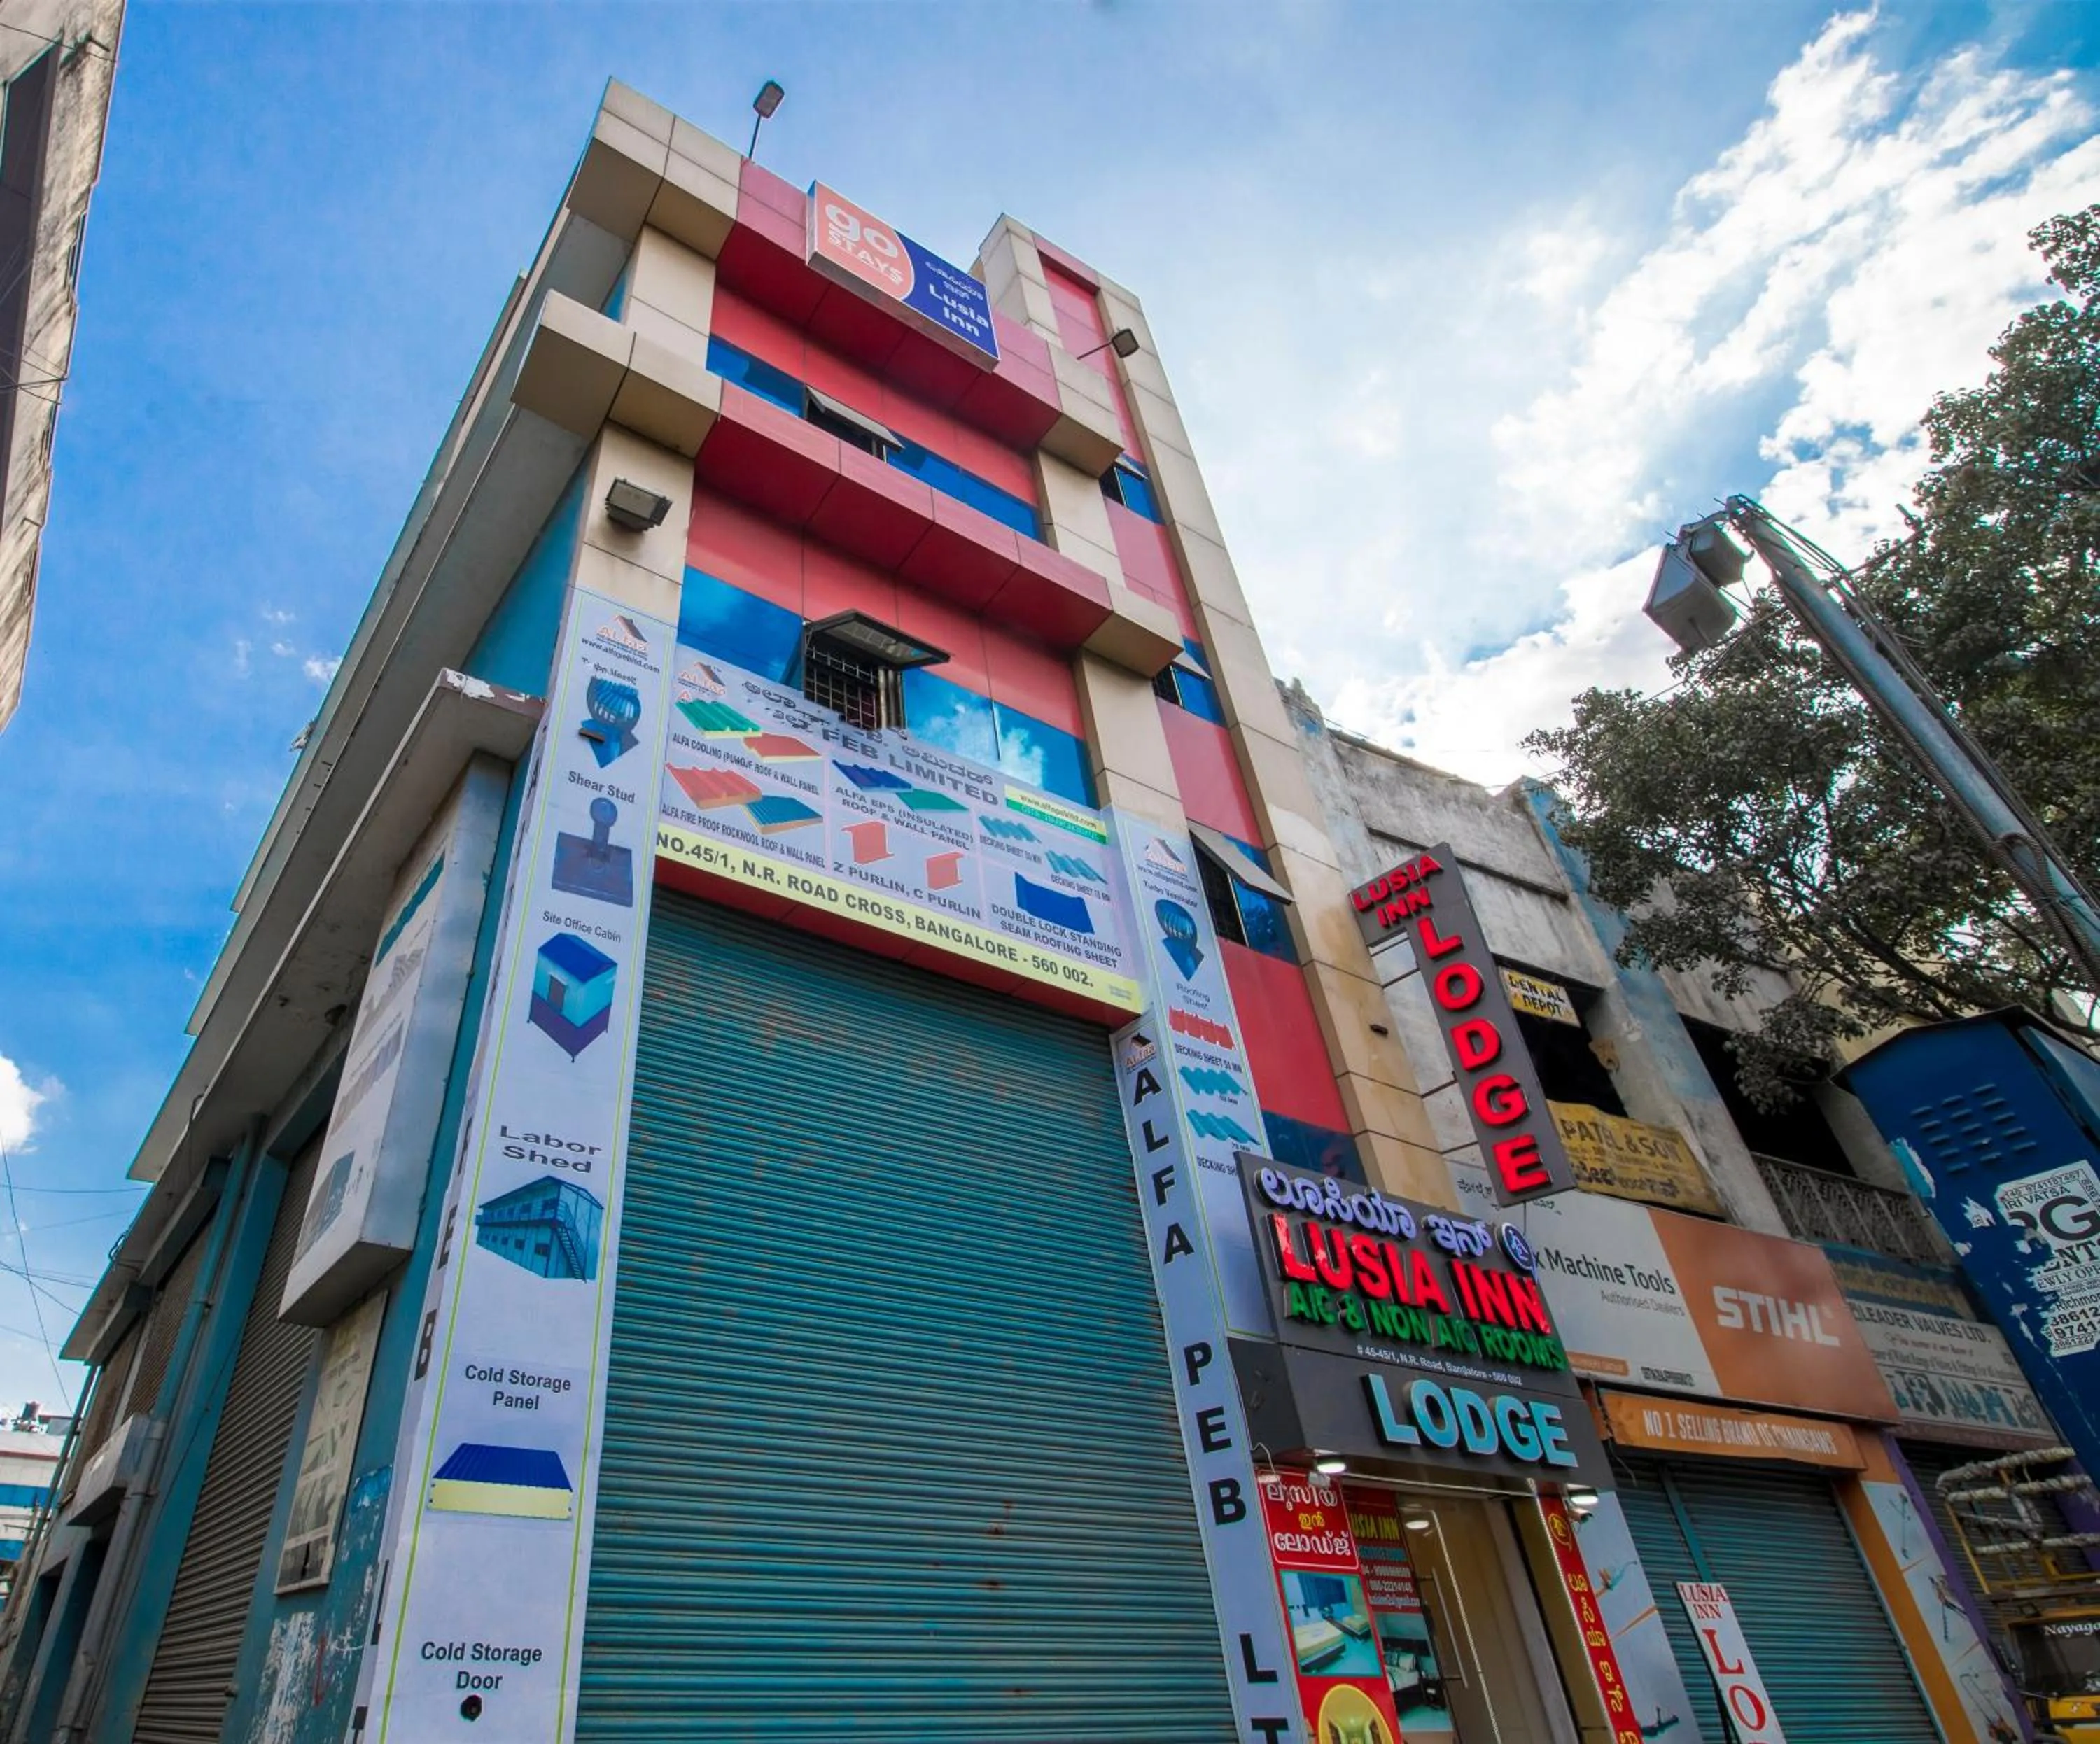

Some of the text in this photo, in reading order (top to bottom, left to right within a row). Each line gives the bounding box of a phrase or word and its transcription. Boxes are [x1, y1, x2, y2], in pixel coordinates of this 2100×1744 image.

[828, 230, 904, 286] STAYS
[929, 283, 989, 328] Lusia
[943, 306, 979, 337] Inn
[568, 770, 636, 804] Shear Stud
[836, 785, 867, 804] ALFA
[889, 752, 999, 806] LIMITED
[841, 798, 878, 817] ROOF
[894, 817, 928, 836] WALL
[931, 831, 970, 851] PANEL
[834, 862, 844, 873] Z
[913, 887, 924, 899] C
[927, 892, 981, 920] PURLIN
[1350, 855, 1443, 910] LUSIA
[657, 831, 736, 874] NO.45/1,
[743, 859, 781, 886] N.R.
[788, 873, 839, 903] ROAD
[845, 893, 911, 930] CROSS,
[914, 914, 1018, 964] BANGALORE
[1031, 955, 1059, 977] 560
[1062, 966, 1095, 989] 002.
[1377, 887, 1432, 929] INN
[542, 910, 622, 943] Site Office Cabin
[991, 903, 1123, 958] DOUBLE LOCK STANDING
[1000, 918, 1119, 969] SEAM ROOFING SHEET
[1508, 972, 1566, 1004] DENTAL
[1522, 994, 1563, 1018] DEPOT
[1417, 916, 1552, 1195] LODGE
[500, 1125, 603, 1157] Labor
[502, 1145, 592, 1174] Shed
[2023, 1186, 2072, 1204] VATSA
[1268, 1212, 1551, 1335] LUSIA INN
[1544, 1247, 1627, 1286] Machine
[1624, 1263, 1676, 1295] Tools
[1133, 1067, 1195, 1265] ALFA
[1183, 1340, 1247, 1526] PEB
[2055, 1293, 2100, 1311] Richmo
[1288, 1281, 1336, 1326] A/C
[1340, 1293, 1364, 1329] &
[1367, 1300, 1432, 1343] NON
[1435, 1316, 1479, 1355] A/C
[1479, 1323, 1568, 1371] ROOMS
[1712, 1285, 1841, 1348] STIHL
[1912, 1315, 1963, 1339] VALVES
[1962, 1322, 1993, 1344] LTD.
[1399, 1353, 1418, 1365] N.R.
[465, 1364, 572, 1394] Cold Storage
[492, 1391, 540, 1410] Panel
[1365, 1373, 1578, 1468] LODGE
[1643, 1409, 1663, 1438] NO
[1664, 1411, 1676, 1439] 1
[1676, 1412, 1723, 1444] SELLING
[1350, 1513, 1379, 1539] USIA
[1680, 1583, 1730, 1603] LUSIA
[1692, 1603, 1723, 1620] INN
[421, 1640, 543, 1667] Cold Storage
[456, 1670, 503, 1689] Door
[1702, 1628, 1768, 1736] LO
